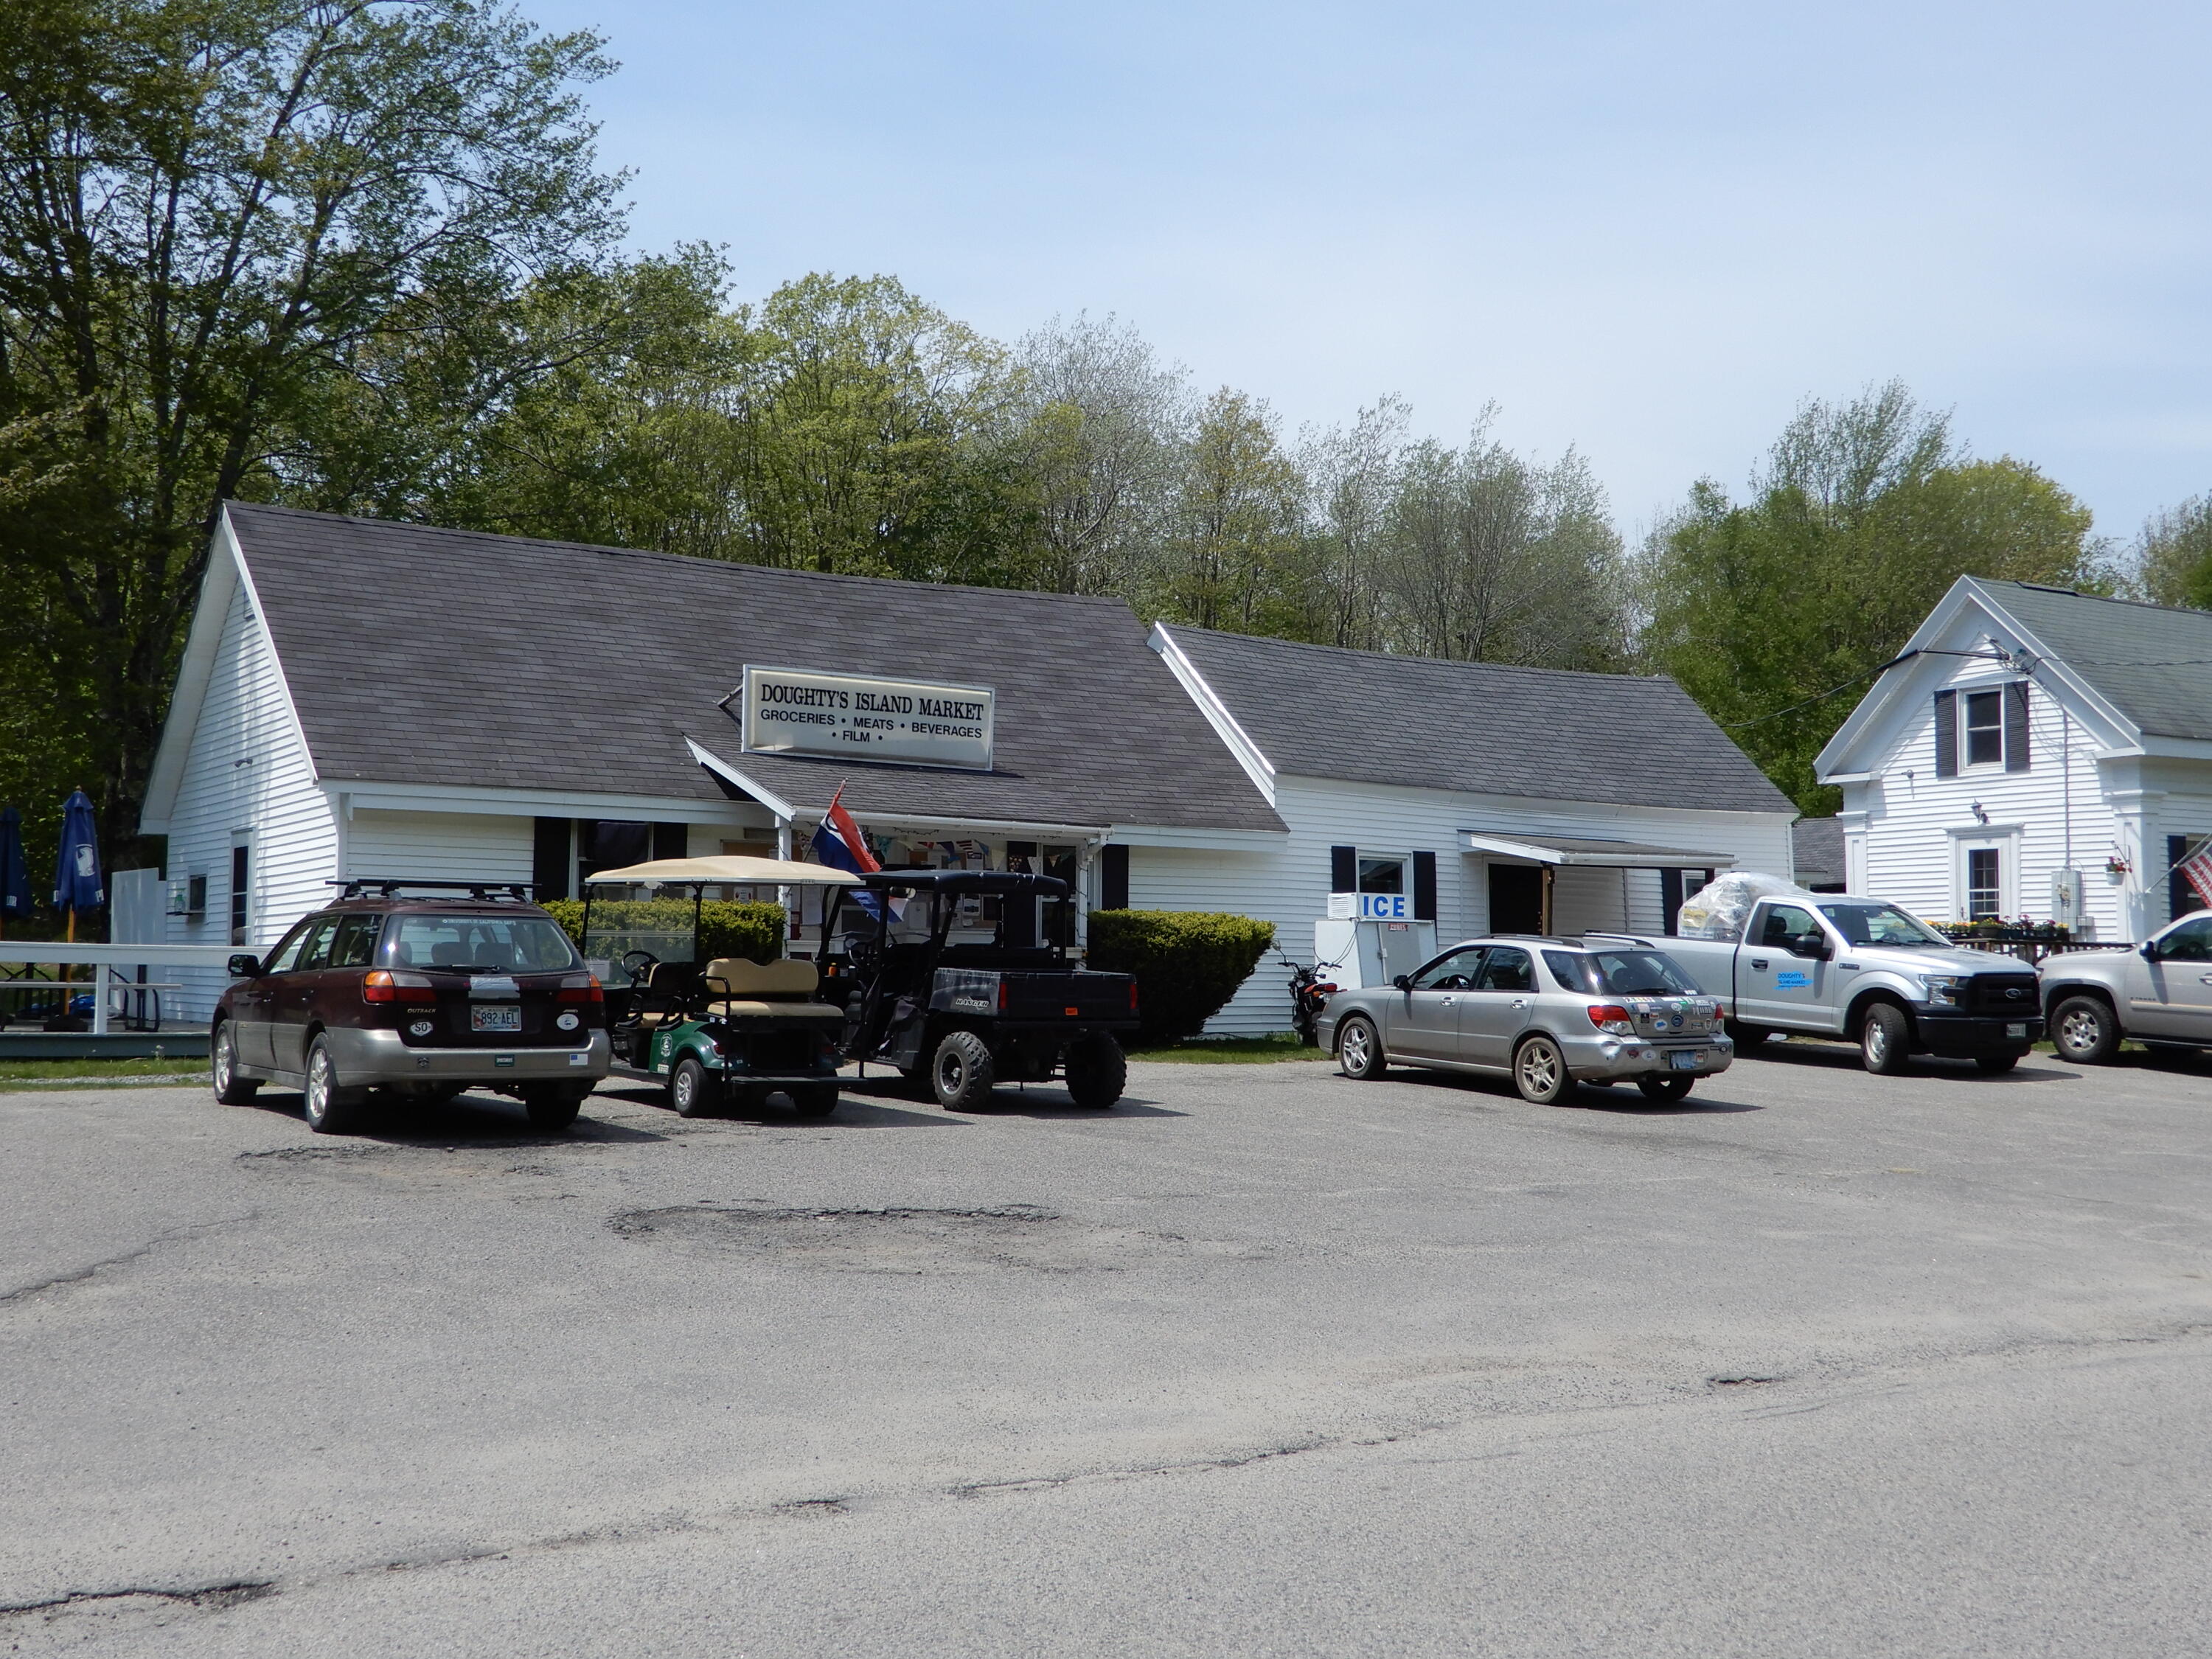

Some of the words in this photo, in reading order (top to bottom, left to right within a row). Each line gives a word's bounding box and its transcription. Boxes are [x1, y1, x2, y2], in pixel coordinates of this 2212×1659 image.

[761, 684, 849, 709] DOUGHTY'S
[855, 692, 913, 714] ISLAND
[919, 698, 984, 721] MARKET
[760, 709, 835, 726] GROCERIES
[853, 717, 894, 731] MEATS
[911, 722, 983, 739] BEVERAGES
[843, 730, 870, 742] FILM
[1363, 895, 1405, 917] ICE
[955, 998, 990, 1008] RANGER
